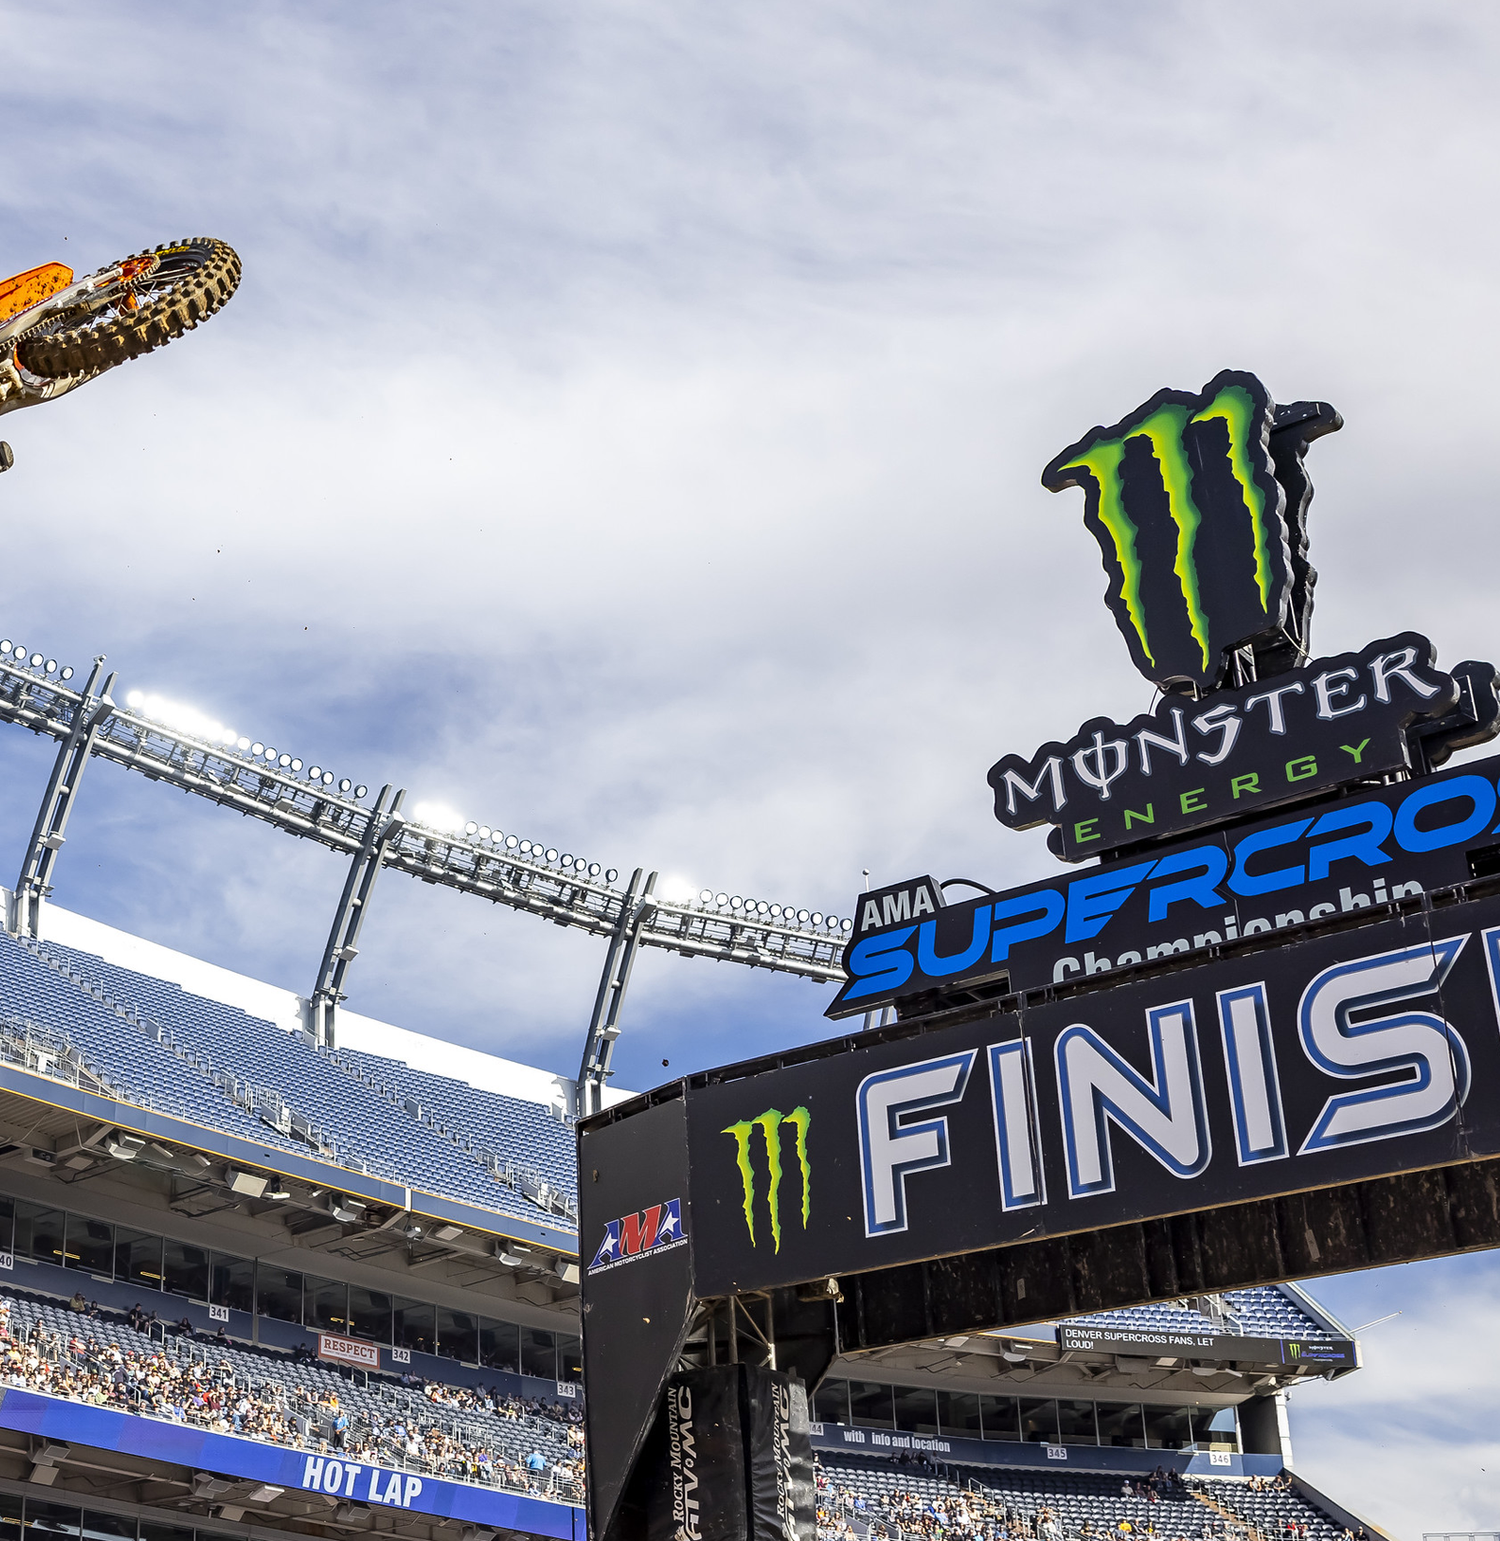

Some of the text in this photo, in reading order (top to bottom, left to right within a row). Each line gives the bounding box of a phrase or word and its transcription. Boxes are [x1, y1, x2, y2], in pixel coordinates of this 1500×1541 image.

[1073, 737, 1371, 844] ENERGY
[842, 774, 1500, 1001] SUPERCRO
[860, 885, 936, 932] AMA
[855, 926, 1500, 1238] FINIS
[587, 1197, 688, 1270] AMA
[587, 1239, 688, 1276] AMERICAN MOTORCYCLIST ASSOCIATION
[210, 1306, 227, 1320] 341
[324, 1338, 375, 1359] RESPECT
[1065, 1328, 1103, 1340] DENVER
[1104, 1331, 1167, 1344] SUPERCROSS
[1197, 1337, 1214, 1348] LET
[1066, 1339, 1094, 1350] LOUD!
[393, 1349, 409, 1362] 342
[558, 1384, 574, 1395] 343
[811, 1423, 822, 1434] 44
[771, 1381, 786, 1519] ROCKY MOUNTAIN
[843, 1430, 951, 1453] with info and location
[1048, 1448, 1066, 1458] 345
[667, 1386, 684, 1523] ROCKY MOUNTAIN
[1212, 1454, 1229, 1464] 346
[302, 1456, 423, 1508] HOT LAP
